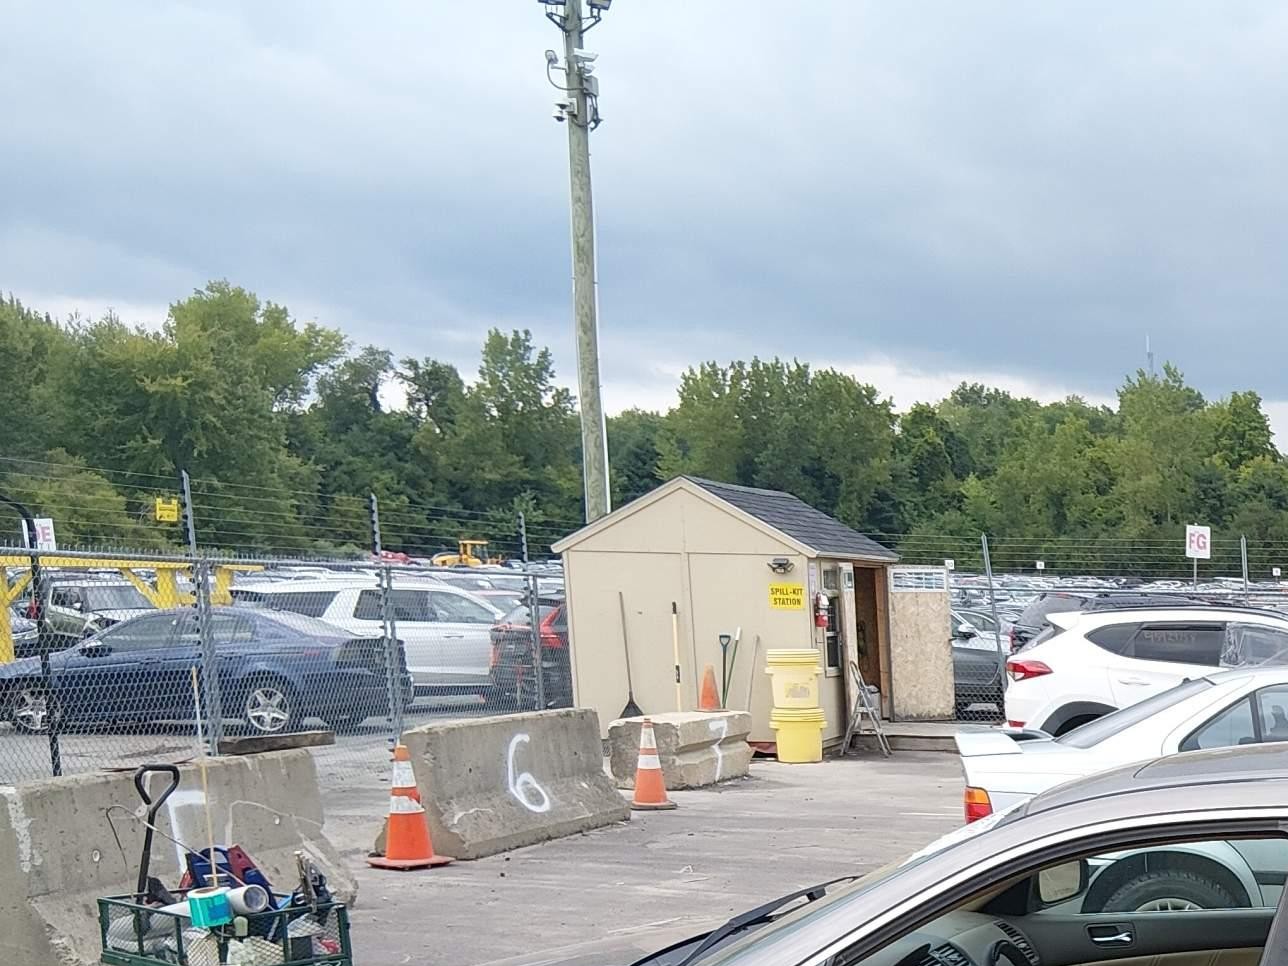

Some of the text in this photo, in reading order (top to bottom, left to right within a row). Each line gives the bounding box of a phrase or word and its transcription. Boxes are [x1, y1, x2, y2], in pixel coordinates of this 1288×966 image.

[1189, 532, 1207, 550] FG
[770, 587, 803, 596] SPILL-KIT
[773, 597, 802, 606] STATION
[508, 733, 550, 813] 6
